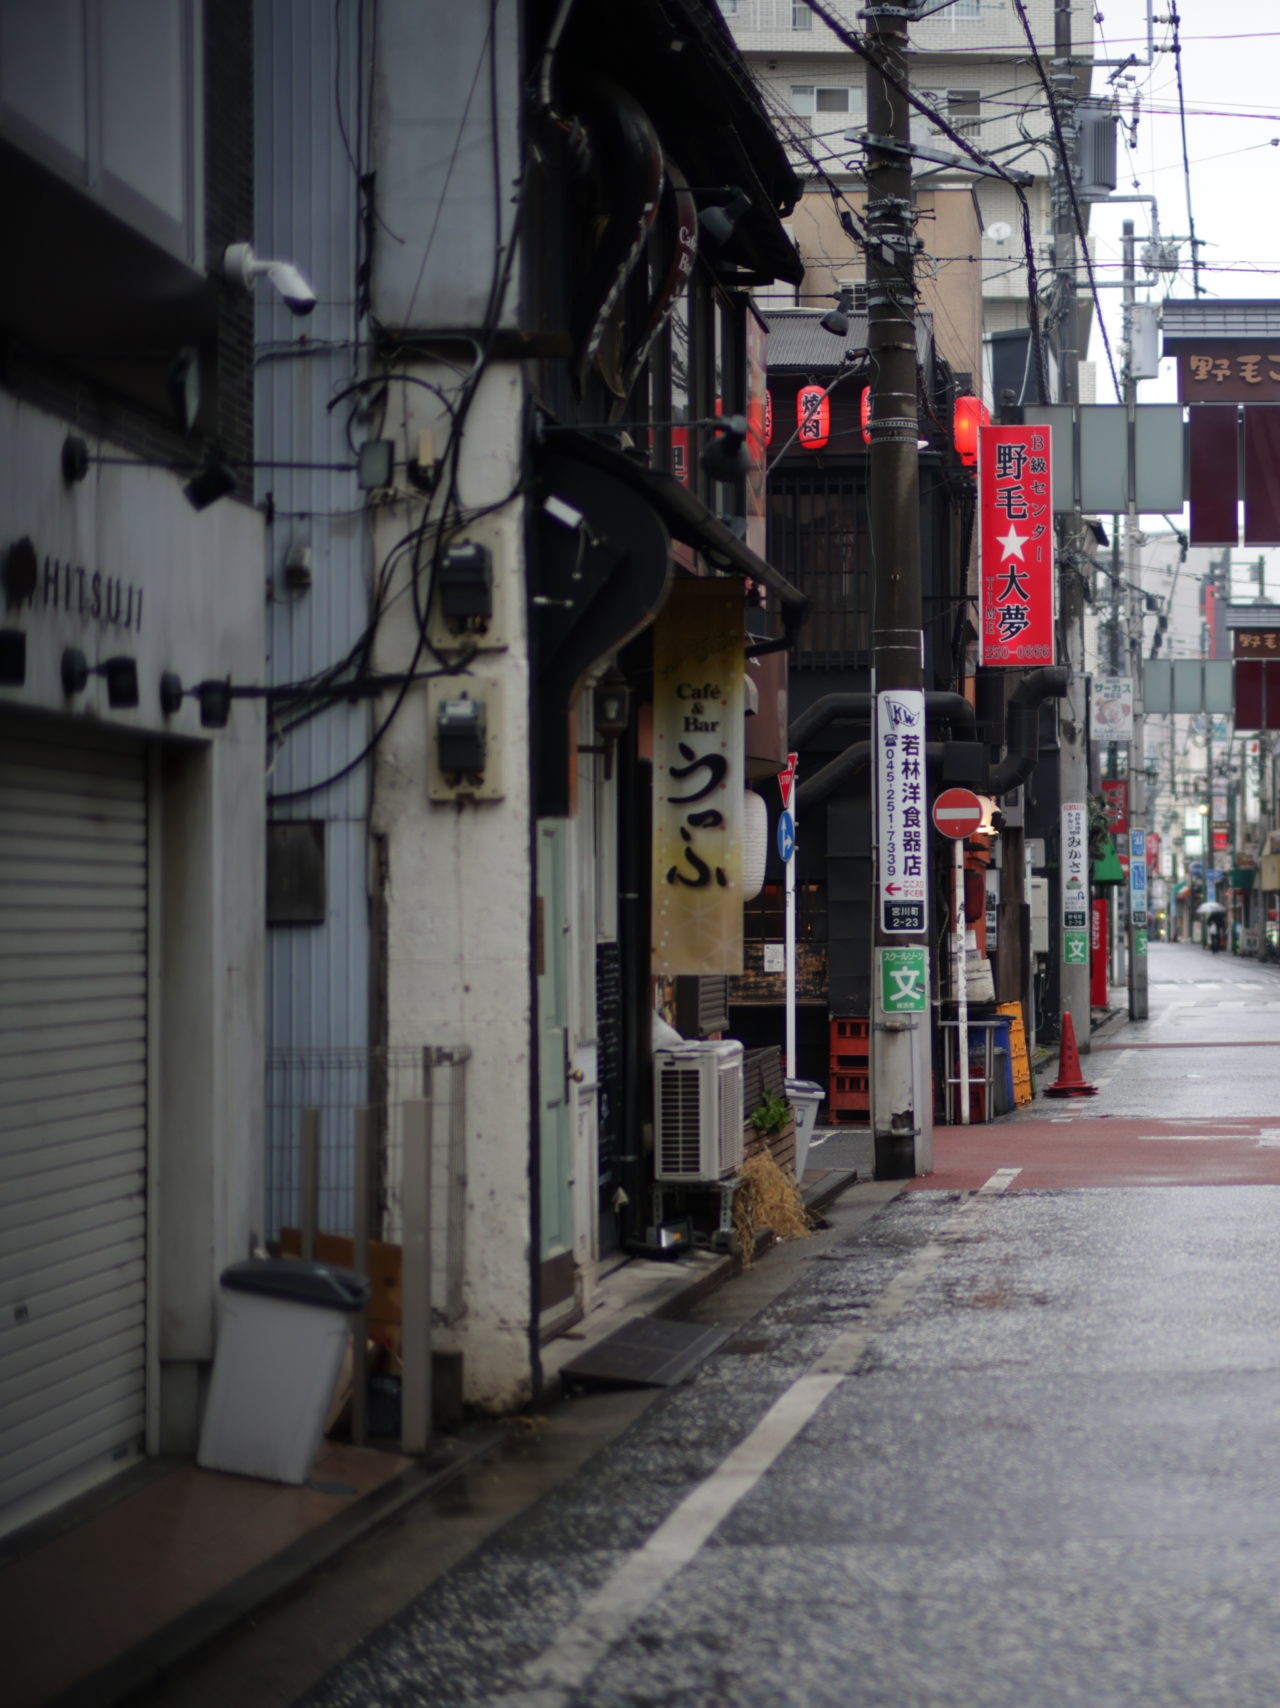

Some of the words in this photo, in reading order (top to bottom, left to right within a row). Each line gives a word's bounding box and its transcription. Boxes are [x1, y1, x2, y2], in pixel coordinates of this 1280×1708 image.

[1030, 435, 1047, 562] B級センター
[43, 555, 143, 633] HITSUJI
[985, 576, 995, 635] TIME
[676, 683, 721, 700] Café
[691, 703, 704, 715] &
[683, 716, 719, 733] Bar
[781, 775, 791, 785] STOP
[886, 749, 896, 876] 045-251-7339
[901, 734, 921, 876] 若林洋食器店
[1067, 836, 1082, 873] みかさ
[893, 918, 919, 927] 2-23
[883, 952, 923, 961] スクールゾーン
[889, 965, 921, 1001] 文
